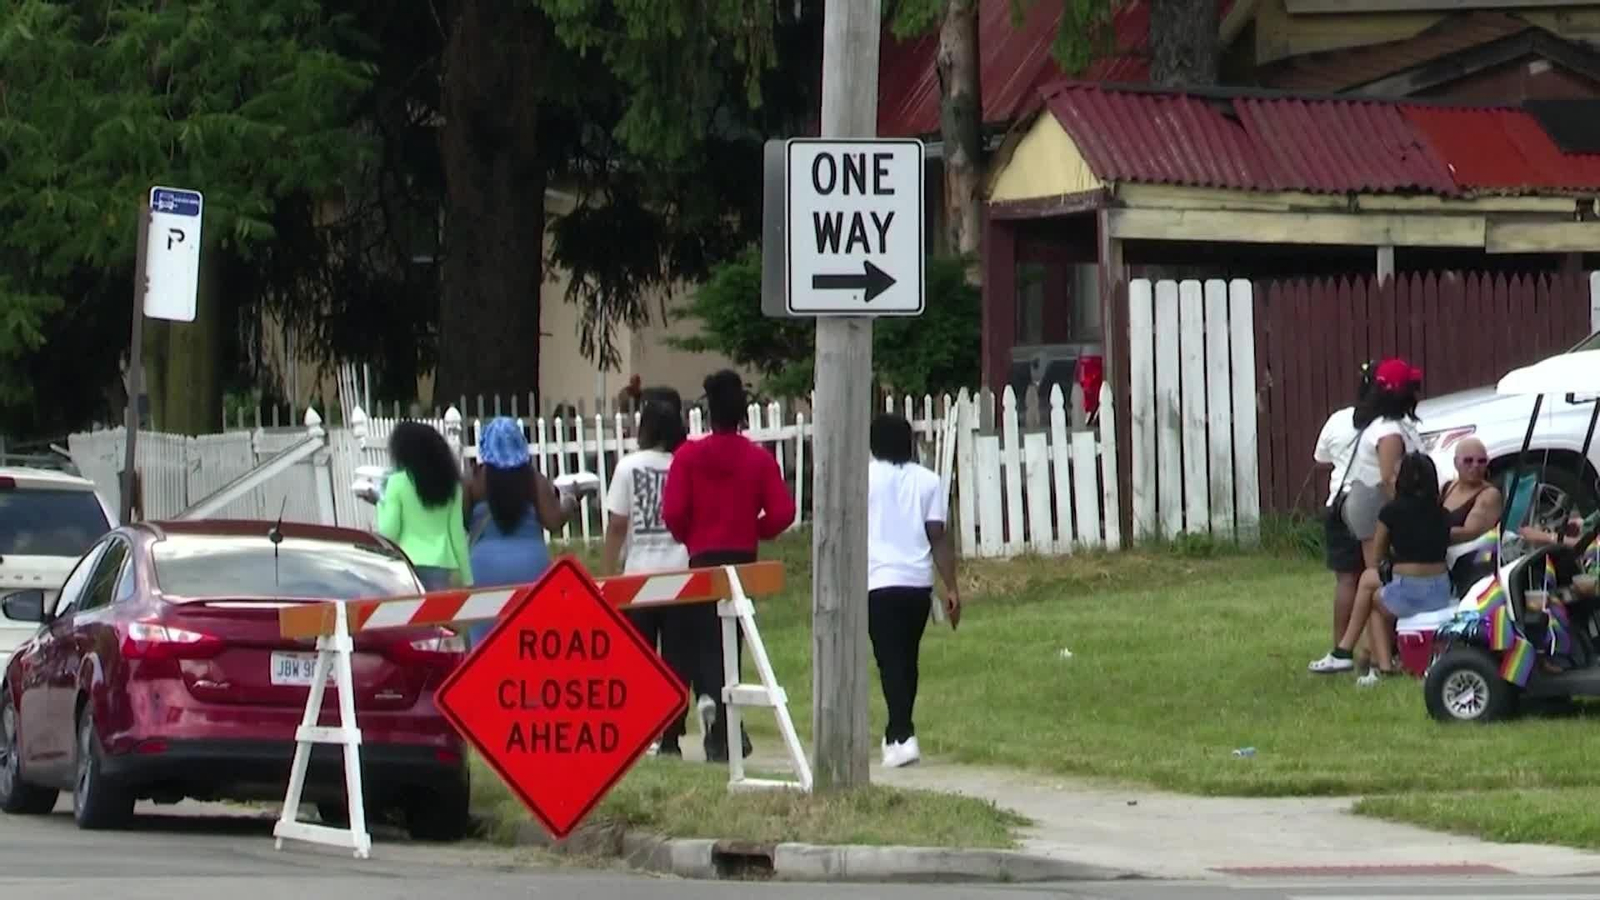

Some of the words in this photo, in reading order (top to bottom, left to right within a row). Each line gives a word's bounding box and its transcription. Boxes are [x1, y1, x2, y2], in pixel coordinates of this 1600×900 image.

[811, 152, 896, 196] ONE
[812, 211, 896, 254] WAY
[518, 628, 611, 661] ROAD
[497, 678, 628, 711] CLOSED
[505, 721, 620, 755] AHEAD
